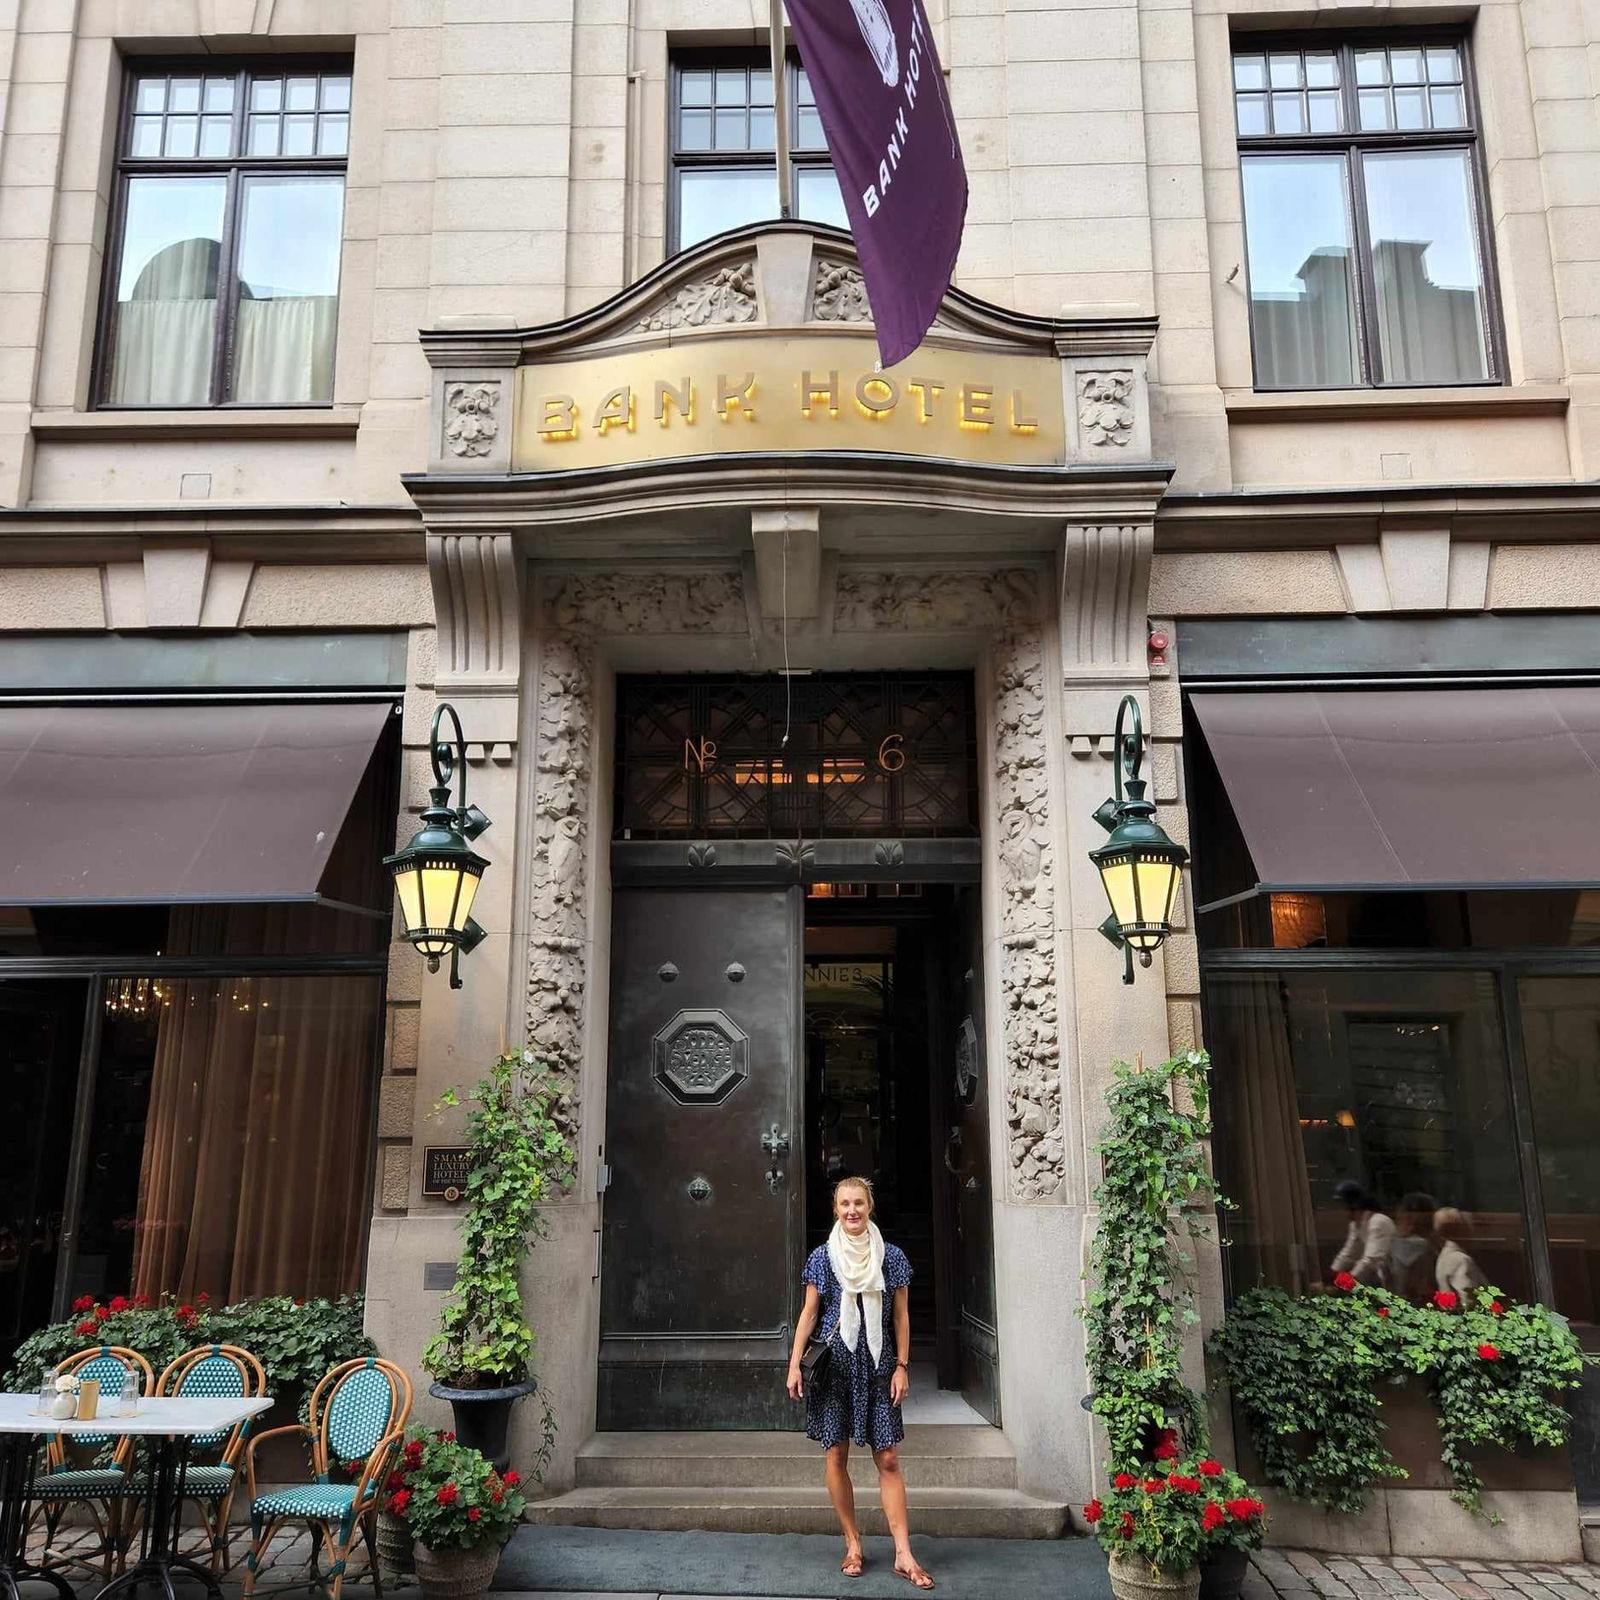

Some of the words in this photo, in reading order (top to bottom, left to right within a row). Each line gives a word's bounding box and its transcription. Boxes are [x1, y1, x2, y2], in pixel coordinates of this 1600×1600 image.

[862, 106, 909, 218] BANK
[536, 371, 756, 436] BANK
[800, 370, 1039, 430] HOTEL
[879, 733, 906, 772] 6
[432, 1162, 471, 1170] LUXURY
